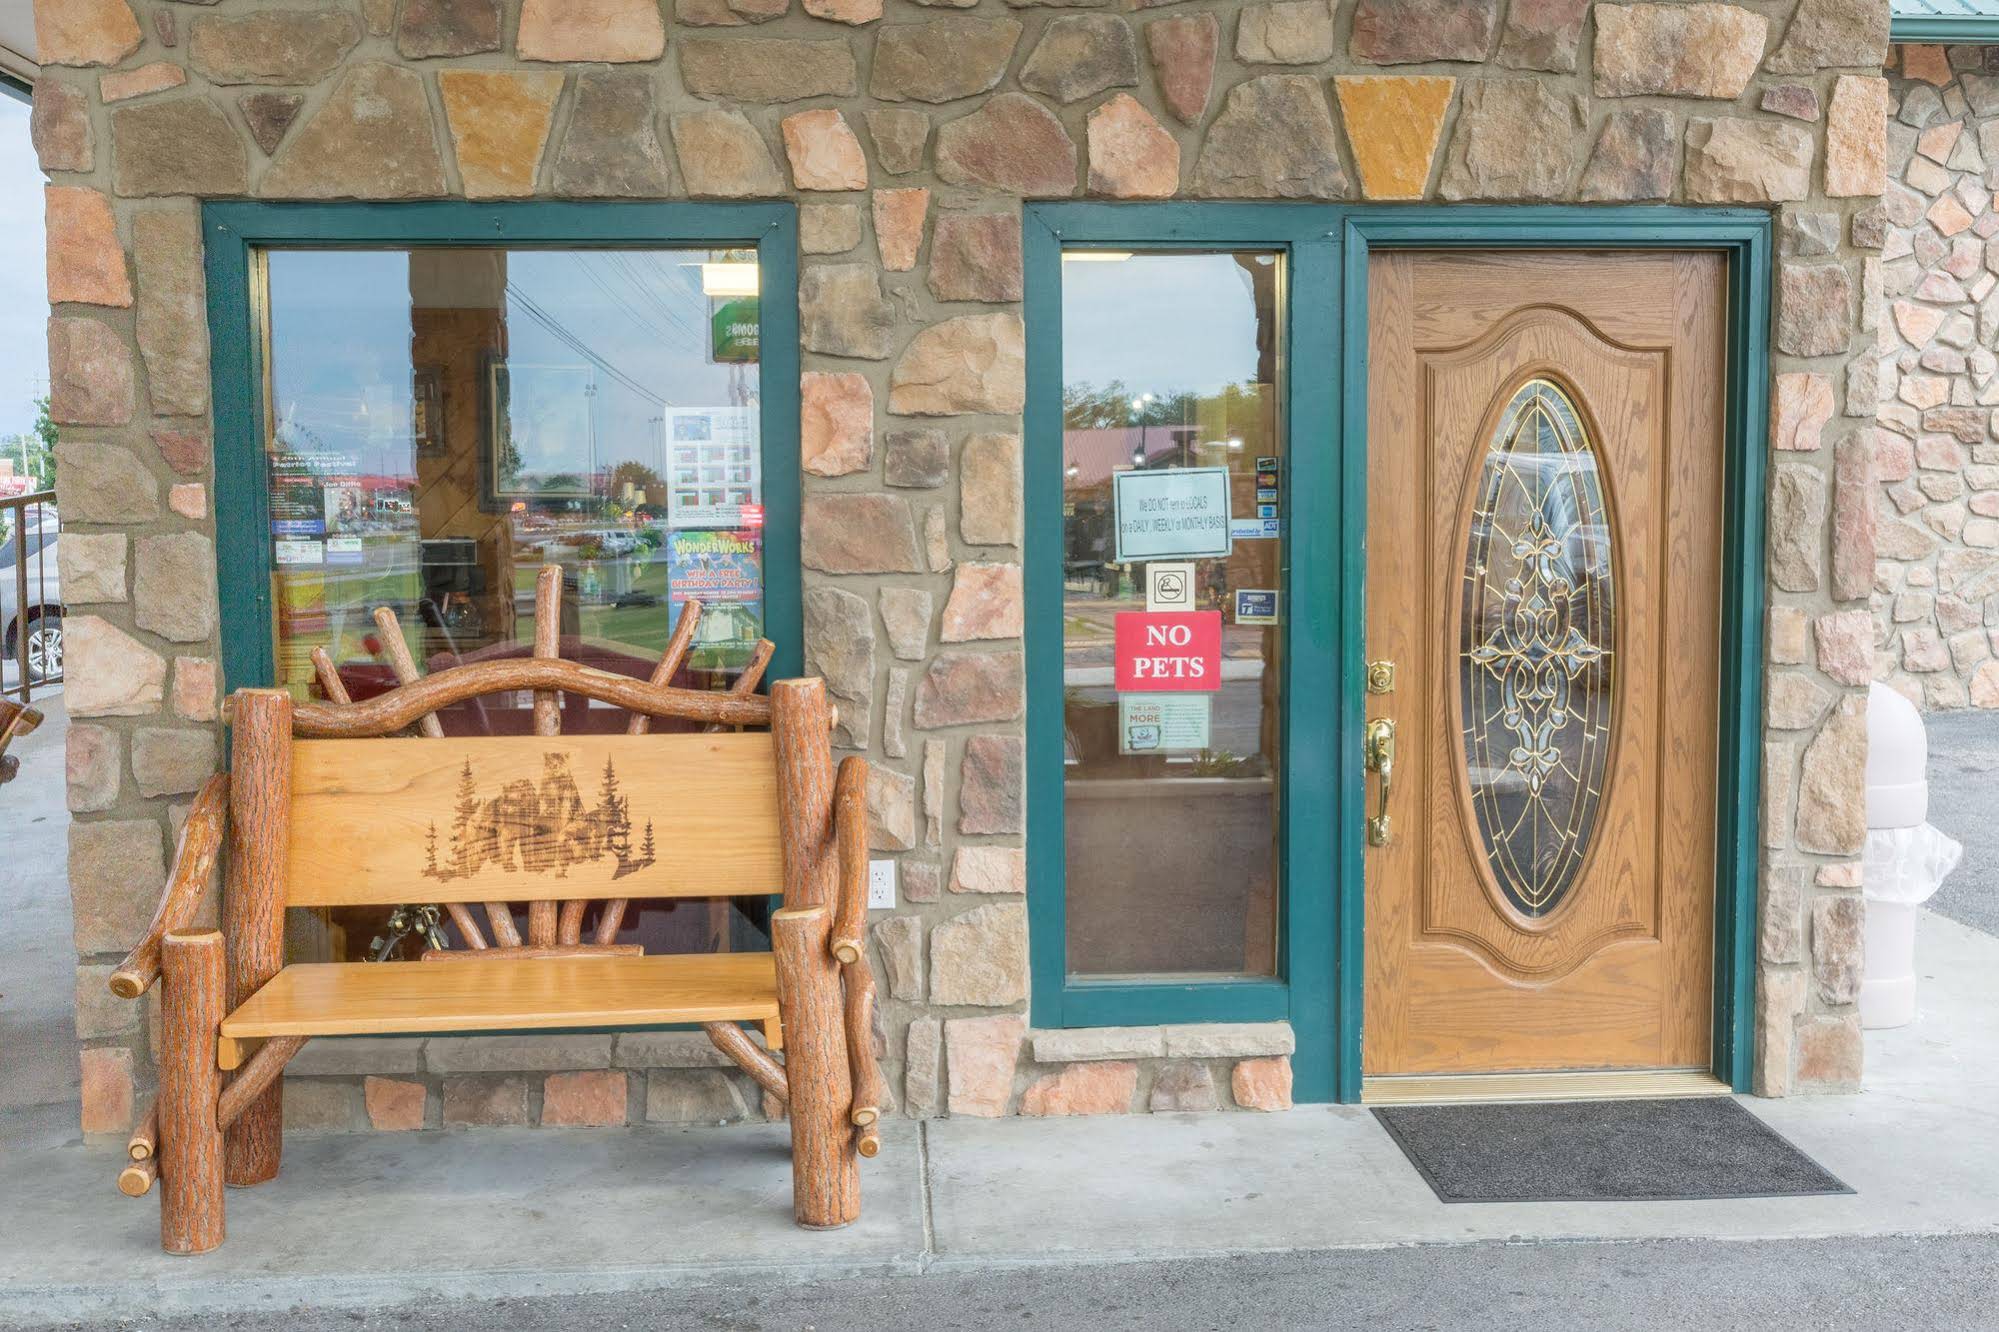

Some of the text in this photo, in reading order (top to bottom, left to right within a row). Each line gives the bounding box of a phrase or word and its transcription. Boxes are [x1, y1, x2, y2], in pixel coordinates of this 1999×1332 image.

[1148, 498, 1157, 512] DO
[1158, 498, 1169, 511] NOT
[1186, 495, 1208, 510] LOCALS
[1133, 519, 1149, 533] DAILY
[1152, 518, 1175, 533] WEEKLY
[1181, 516, 1208, 531] MONTHLY
[1264, 521, 1278, 530] ADT
[709, 569, 716, 577] A
[671, 579, 719, 589] BIRTHDAY
[721, 578, 752, 588] PARTY
[1146, 624, 1192, 647] NO
[1133, 656, 1205, 678] PETS
[1130, 714, 1160, 722] MORE
